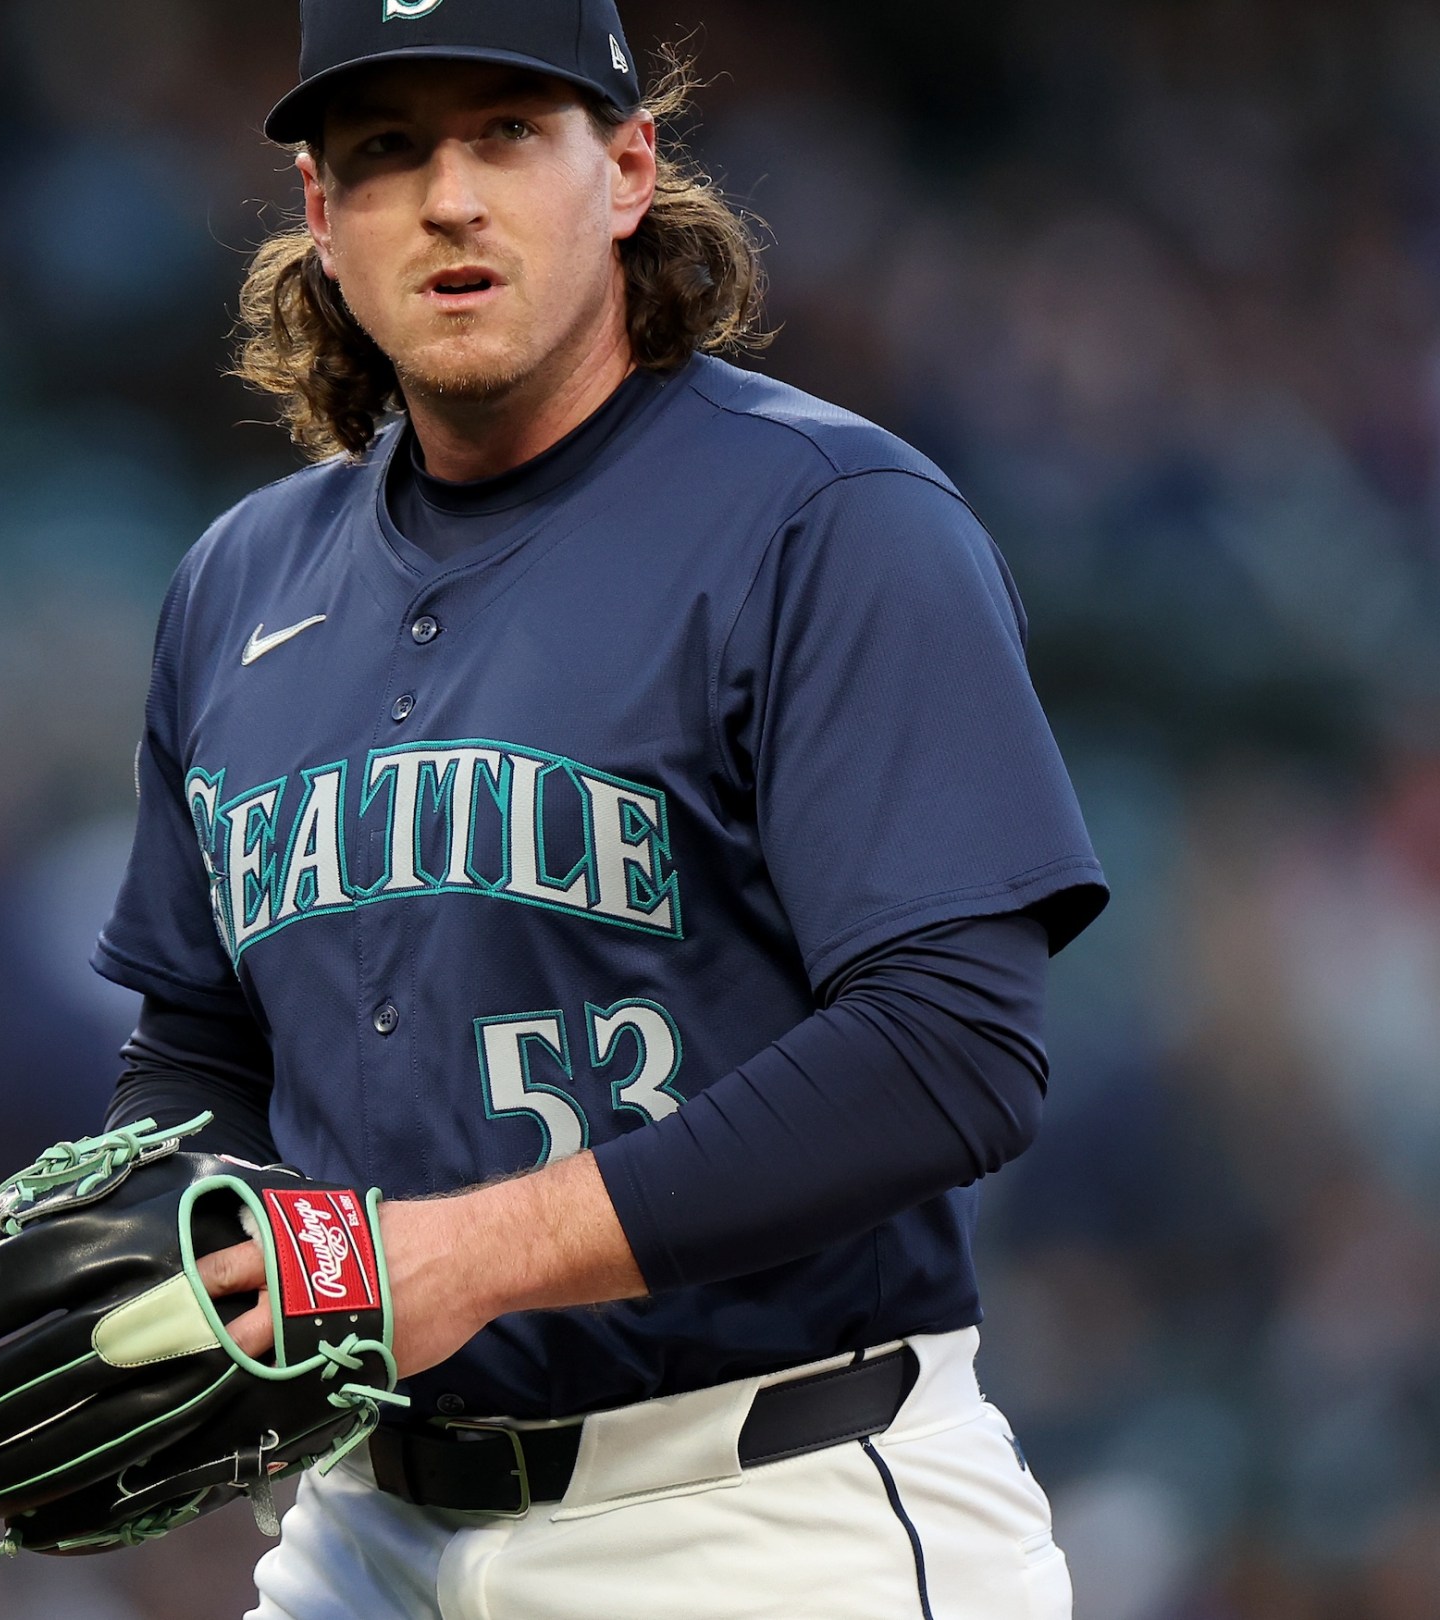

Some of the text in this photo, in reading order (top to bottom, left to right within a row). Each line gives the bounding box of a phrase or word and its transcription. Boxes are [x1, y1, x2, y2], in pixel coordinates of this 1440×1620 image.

[185, 738, 684, 980] SEATTLE
[473, 998, 687, 1168] 53
[294, 1198, 347, 1298] Rawlings
